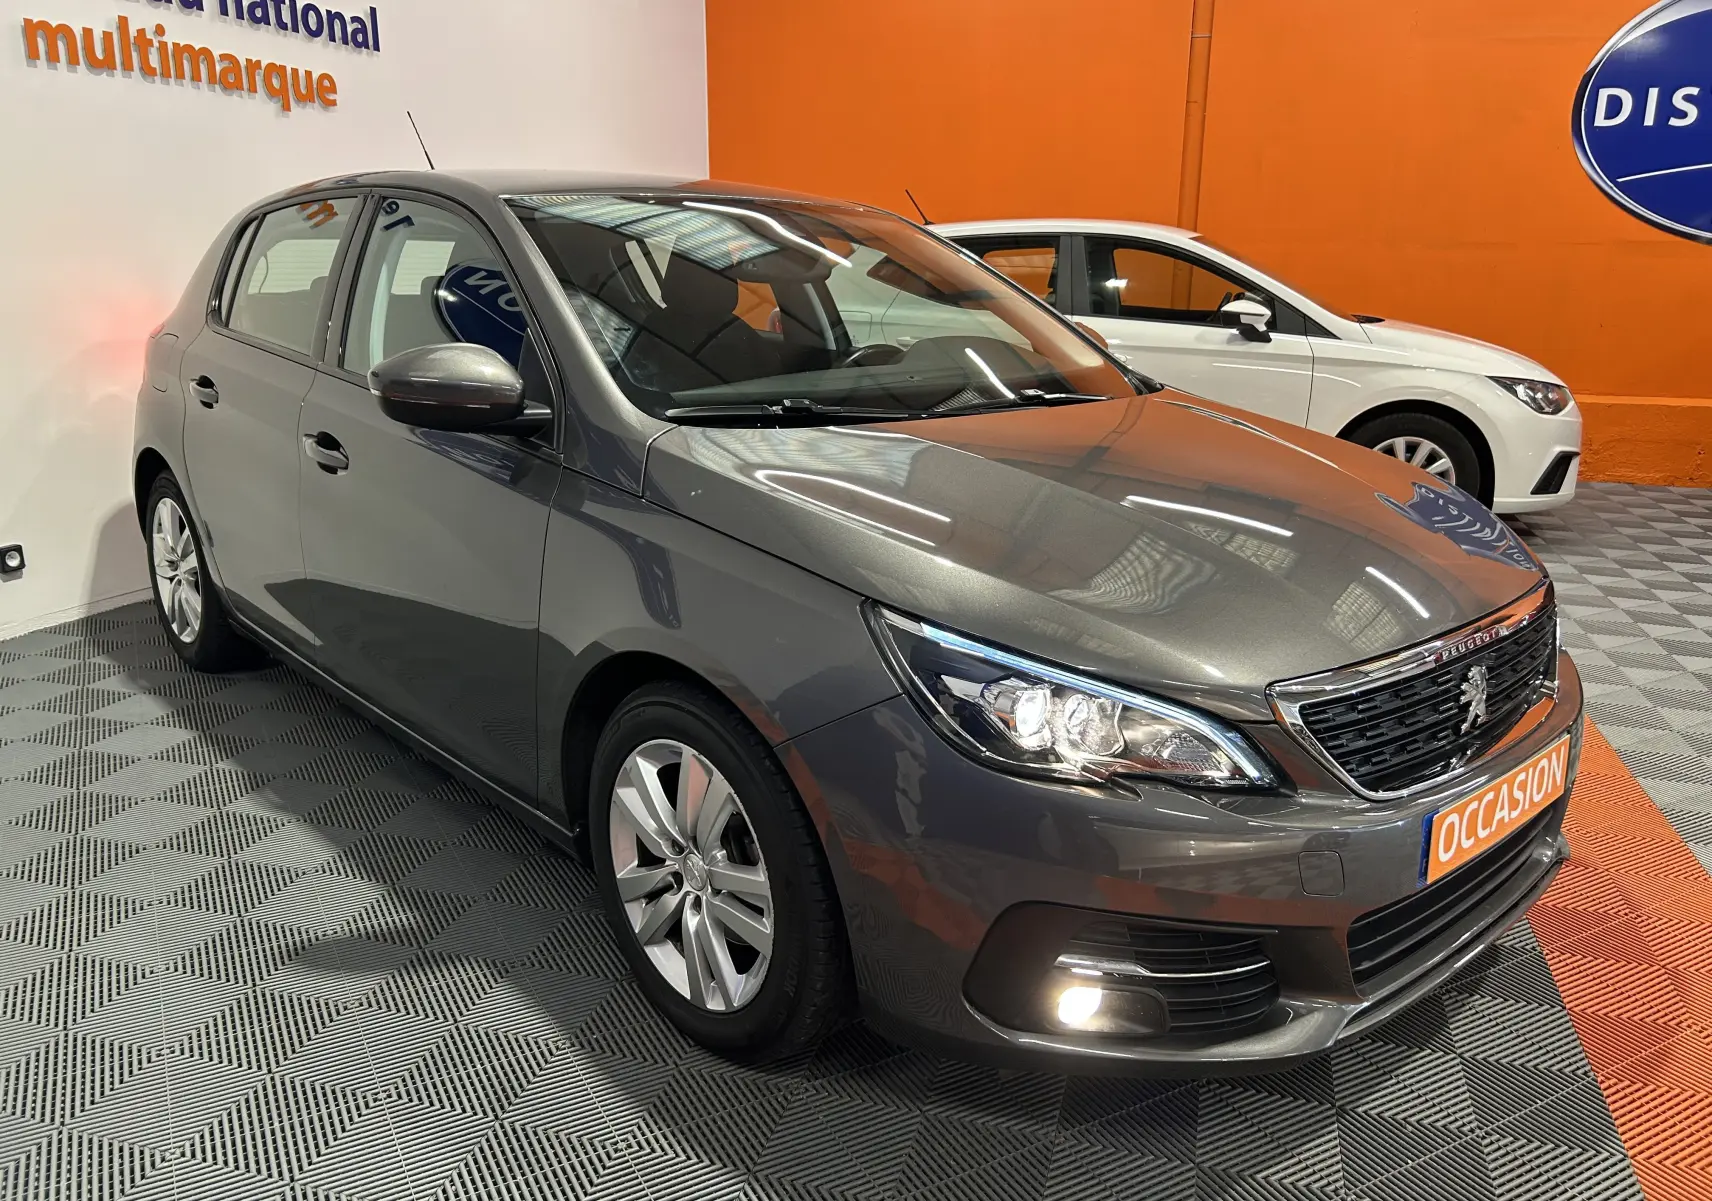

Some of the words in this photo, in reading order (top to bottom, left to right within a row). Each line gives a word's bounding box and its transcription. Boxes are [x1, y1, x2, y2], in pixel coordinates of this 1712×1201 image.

[23, 15, 337, 112] multimarque
[1594, 86, 1700, 127] DIS
[1442, 628, 1498, 660] PEUGEOT
[1438, 745, 1566, 863] OCCASION
